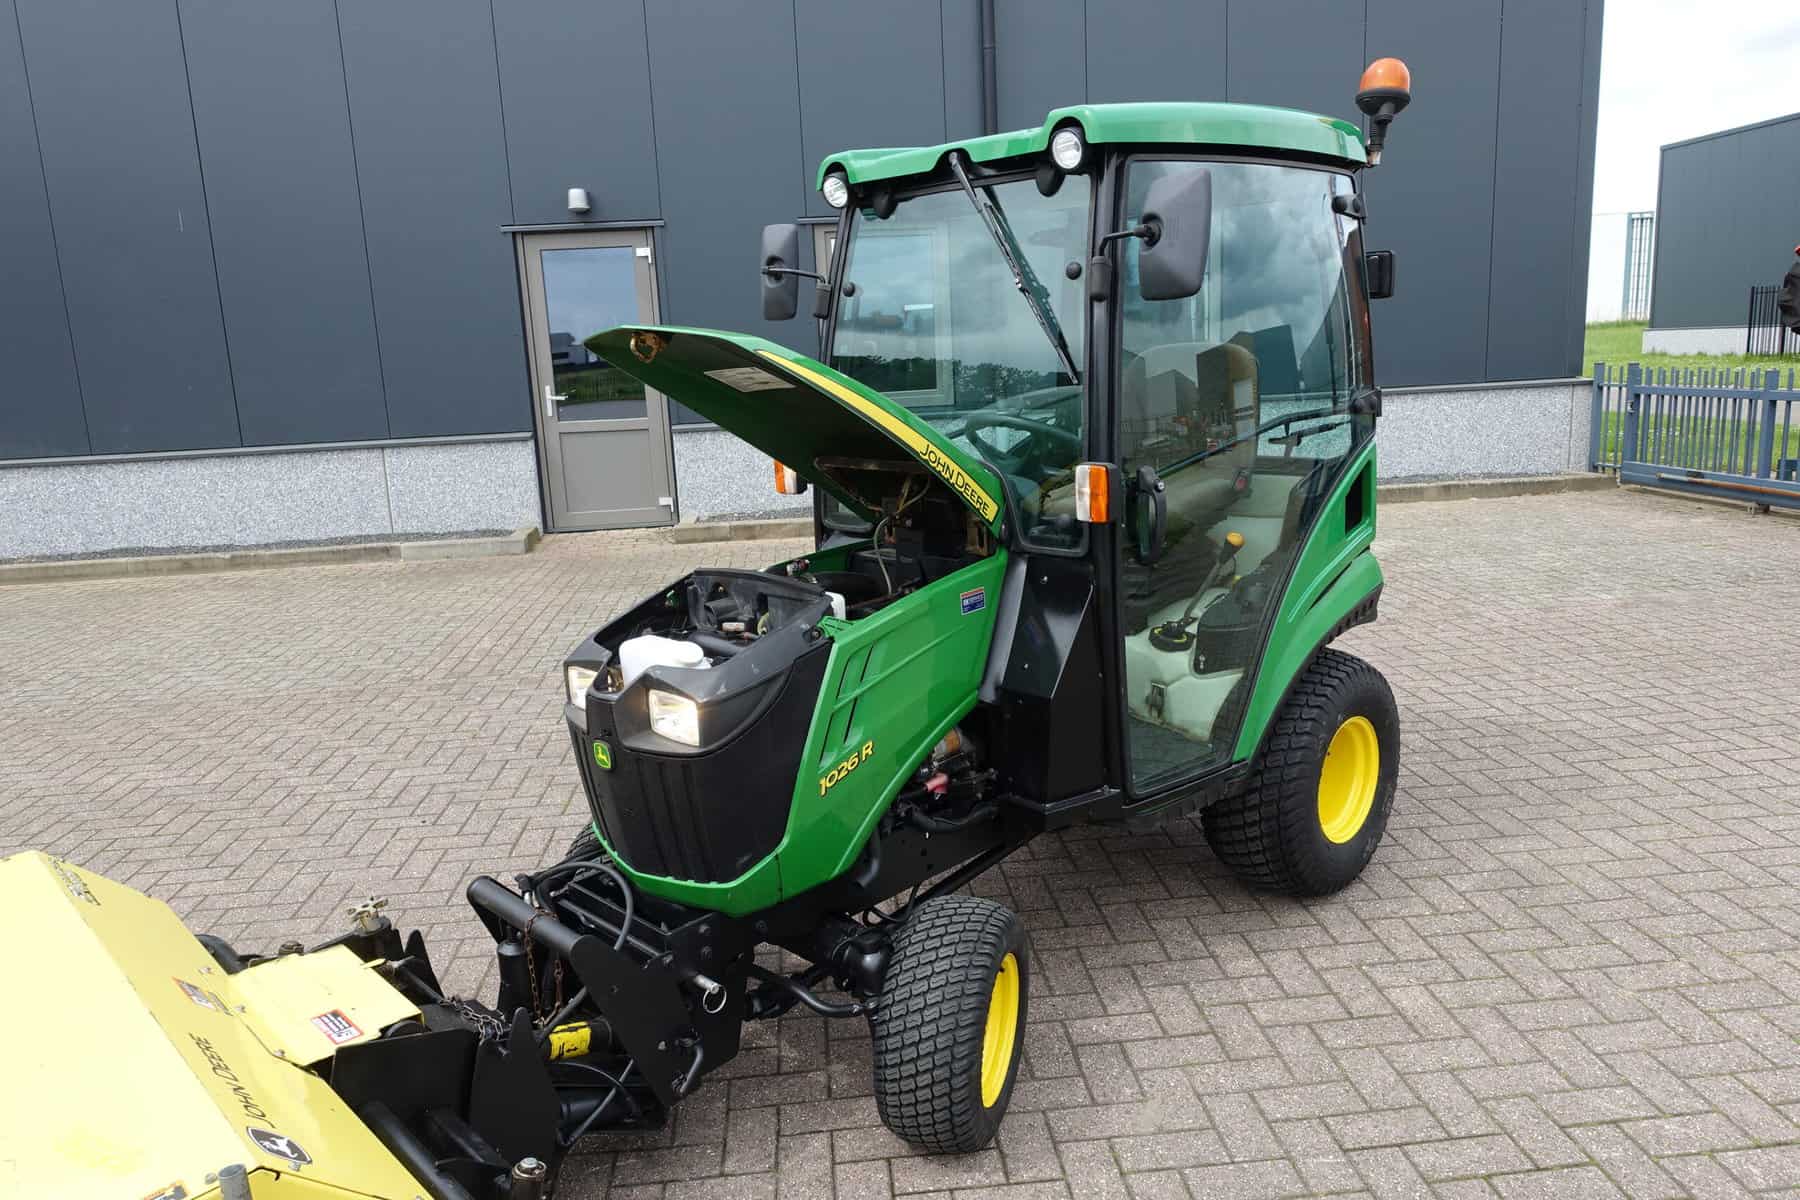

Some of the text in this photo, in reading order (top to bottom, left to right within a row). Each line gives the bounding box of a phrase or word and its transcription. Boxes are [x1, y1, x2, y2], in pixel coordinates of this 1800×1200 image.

[919, 443, 990, 517] JOHN DEERE
[819, 740, 874, 797] 1026 R
[188, 1032, 239, 1083] DEERE
[225, 1081, 276, 1129] JOHN
